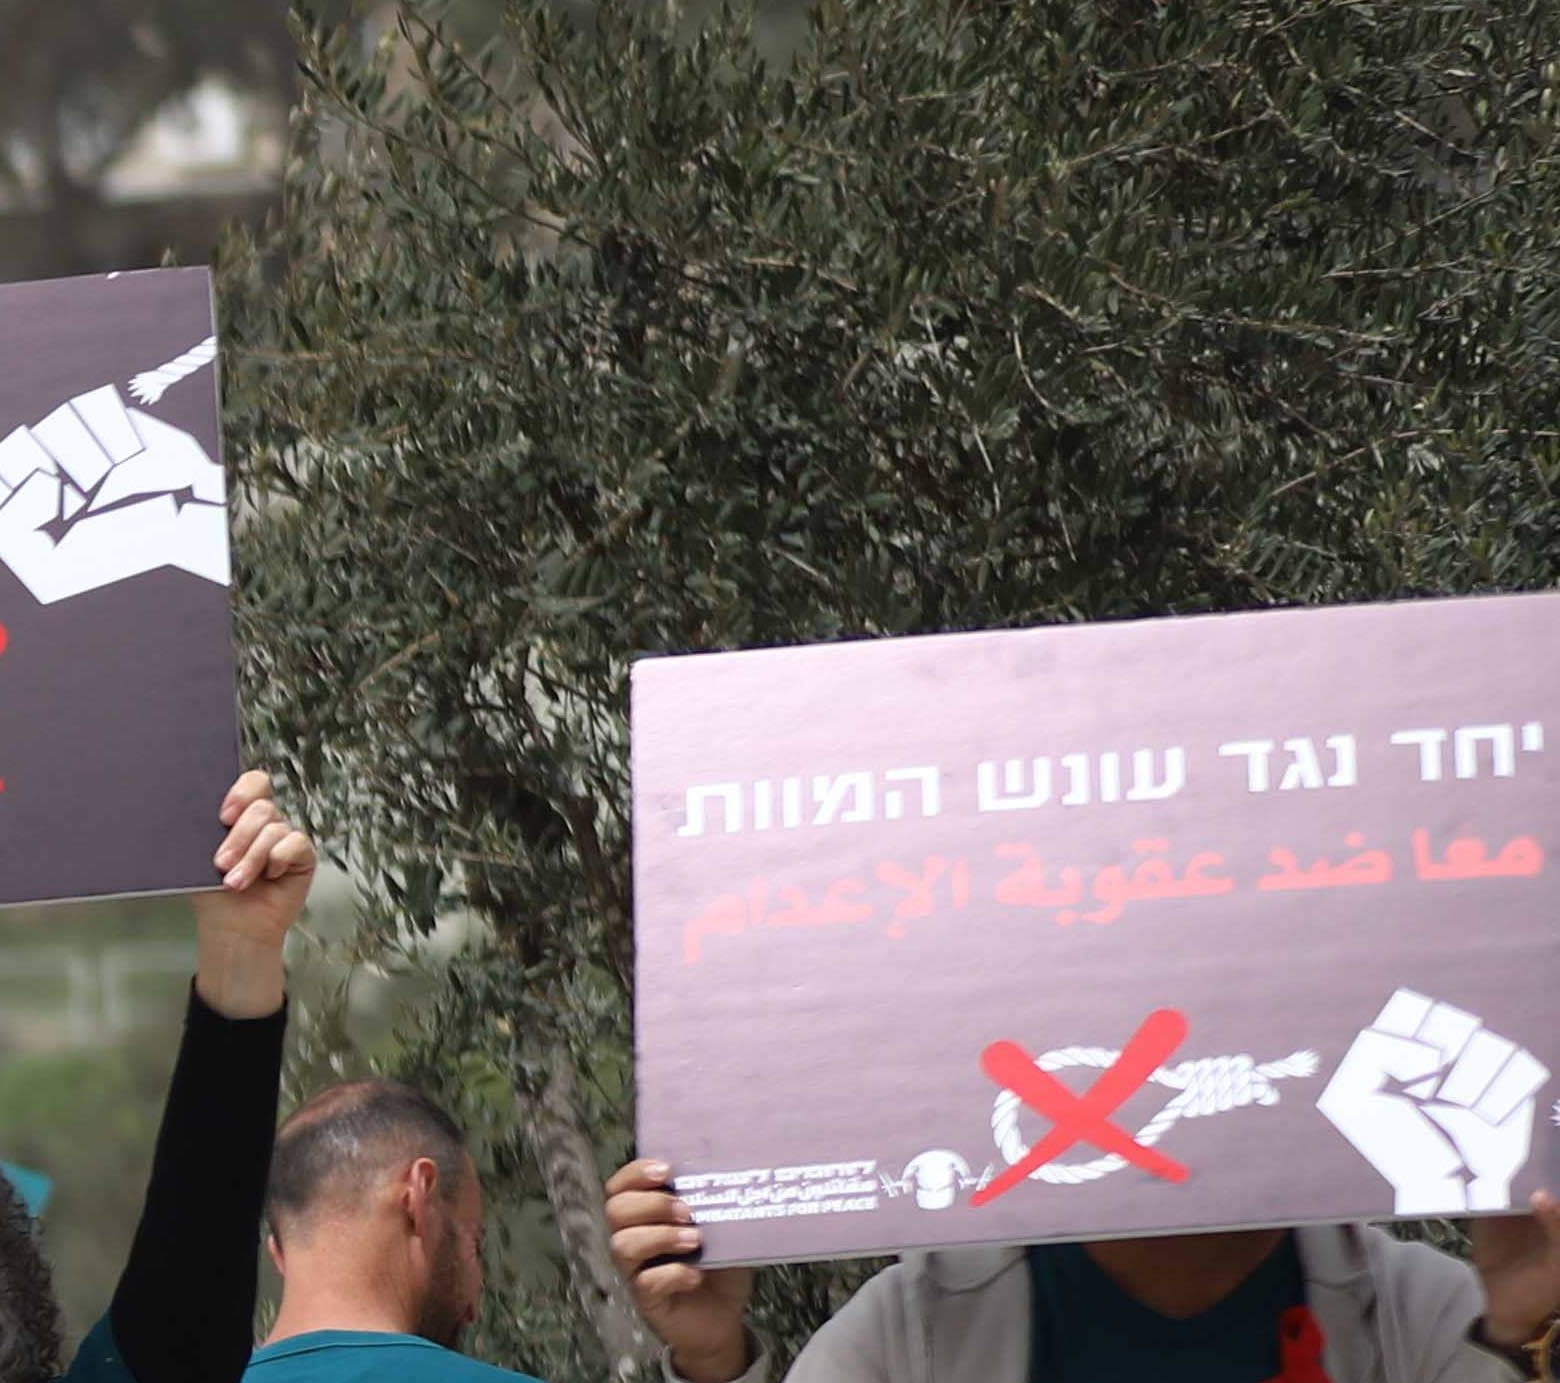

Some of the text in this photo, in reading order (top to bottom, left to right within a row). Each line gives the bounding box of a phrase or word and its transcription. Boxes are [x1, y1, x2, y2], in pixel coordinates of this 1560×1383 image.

[677, 722, 1543, 838] יחד נגד עונש המוות
[684, 829, 1543, 964] معا ضد عقوبة الإعدام
